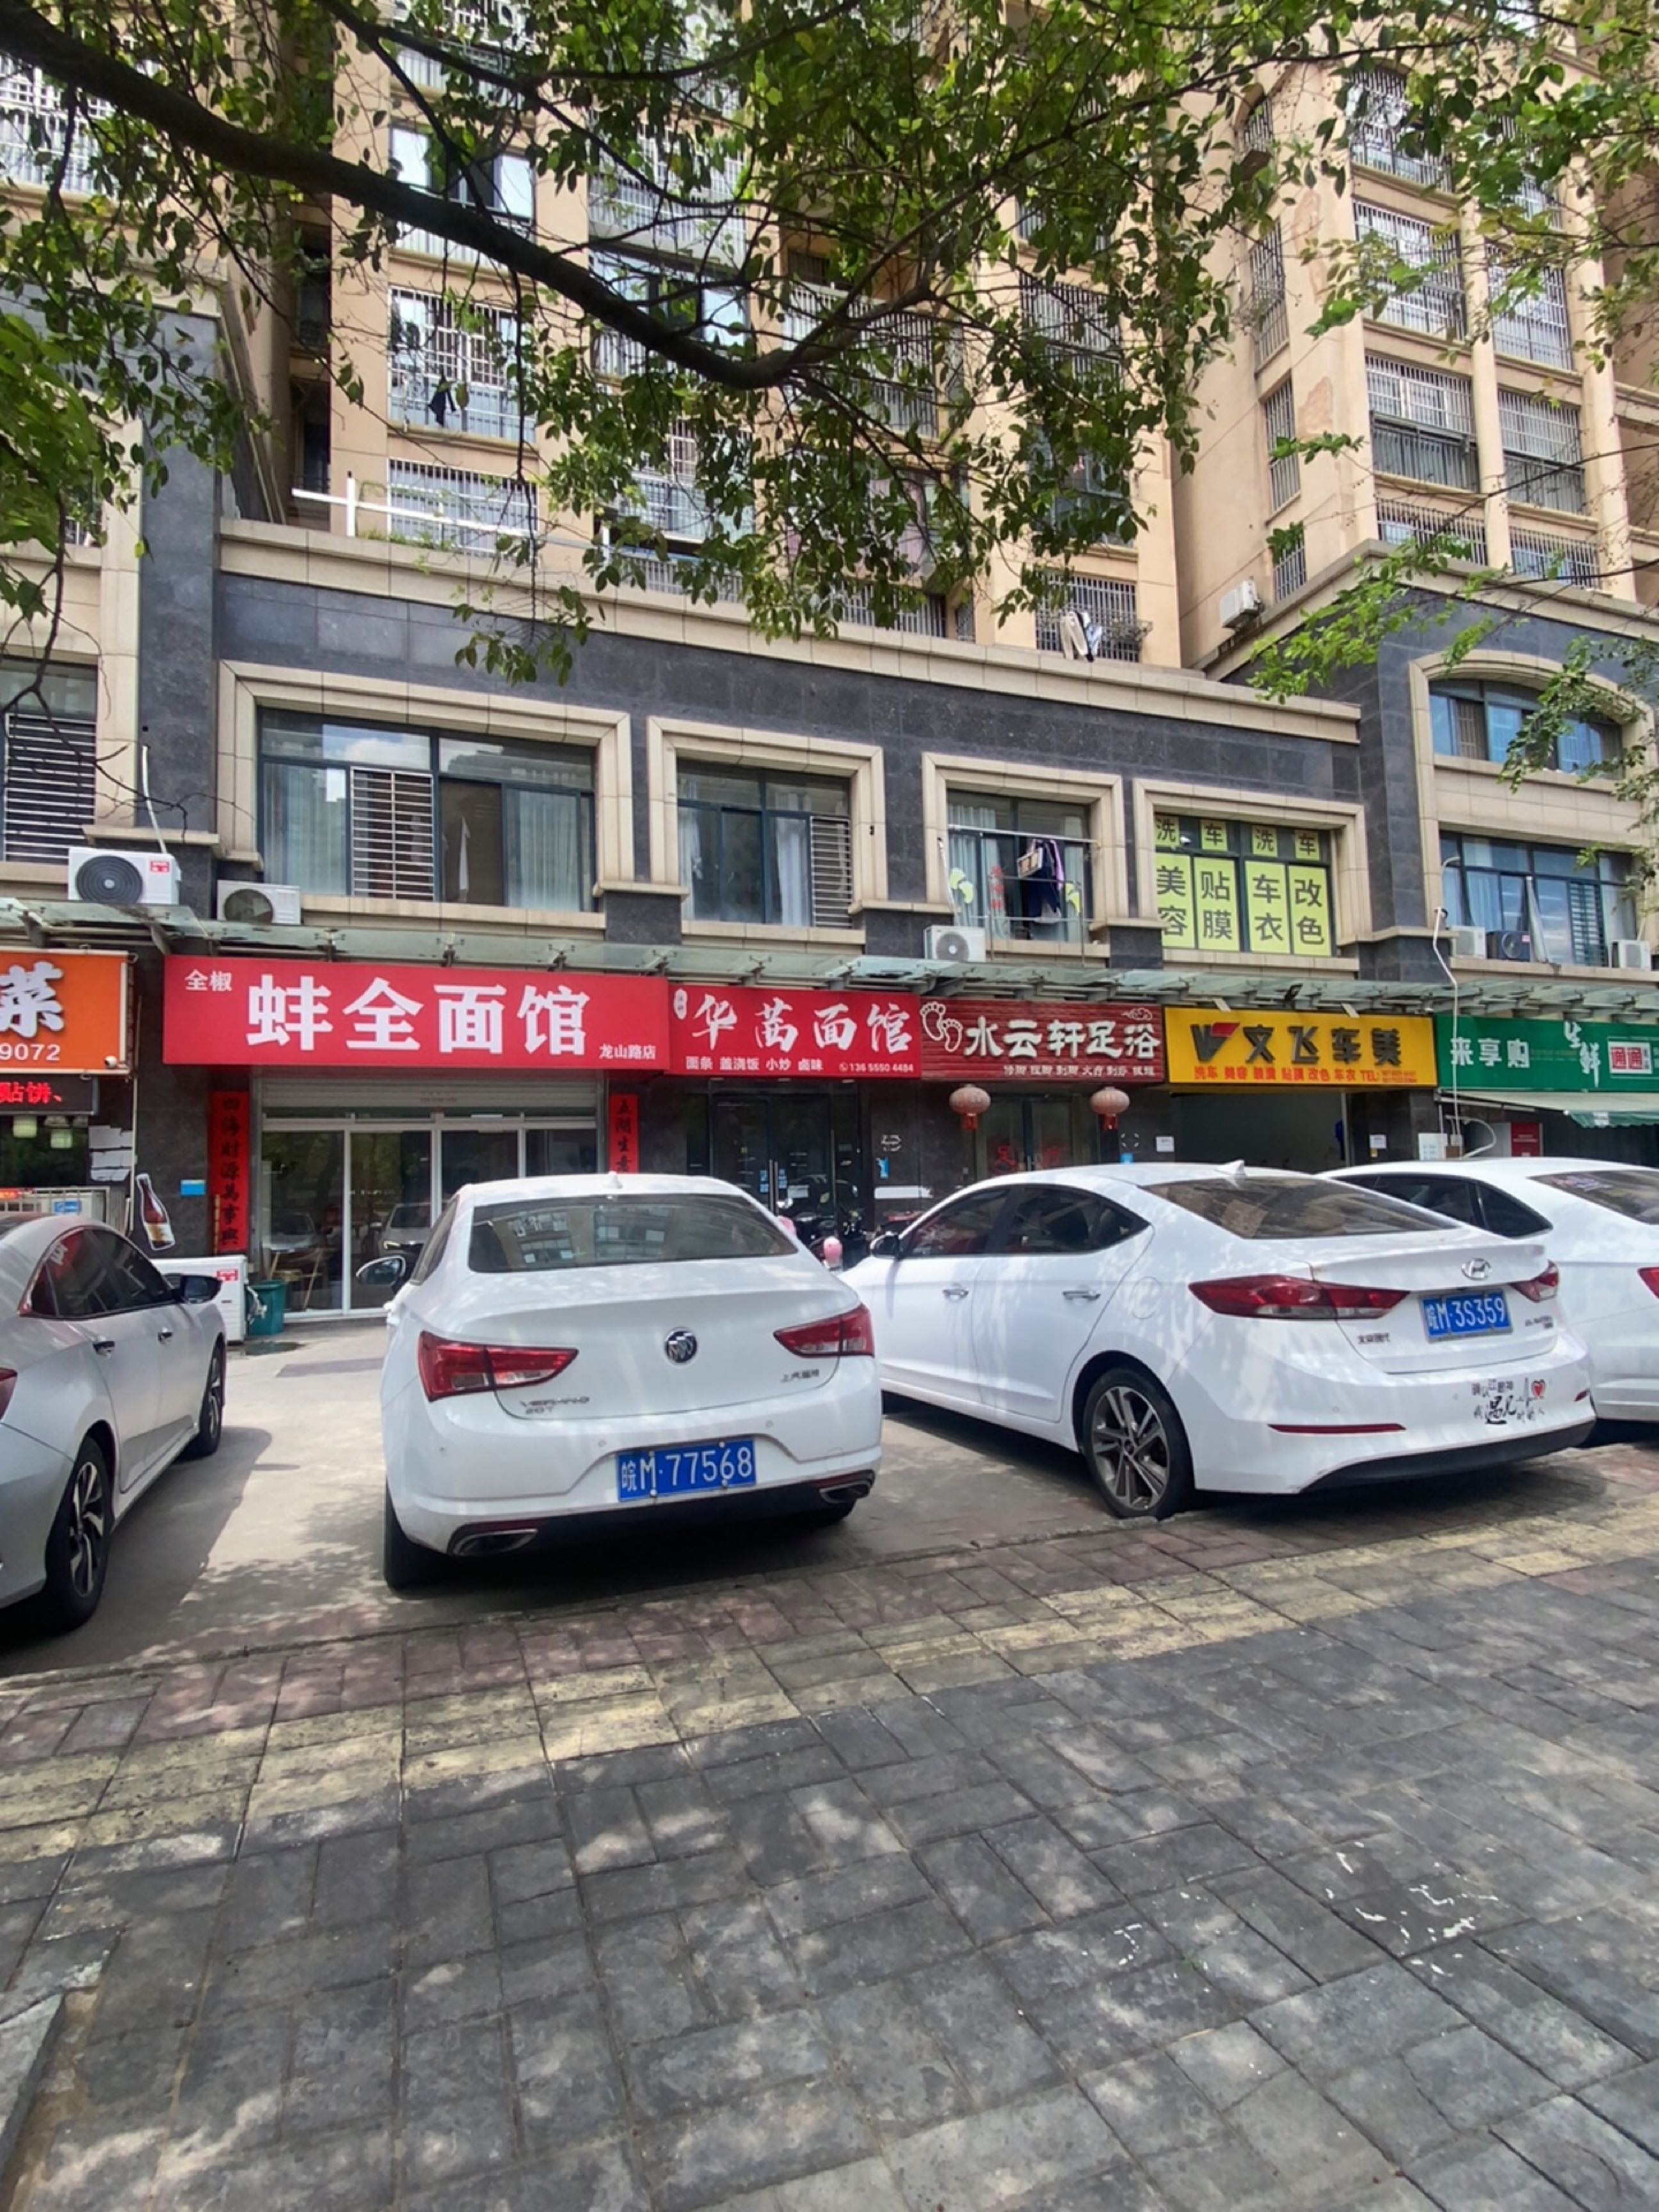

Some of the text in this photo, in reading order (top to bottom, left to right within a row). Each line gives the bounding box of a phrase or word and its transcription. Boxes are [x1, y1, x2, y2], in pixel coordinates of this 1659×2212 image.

[1157, 865, 1187, 936] 美容
[1200, 870, 1232, 940] 贴膜
[1252, 874, 1283, 942] 车衣
[1294, 879, 1324, 945] 改色
[185, 970, 232, 992] 全椒
[246, 974, 591, 1055] 蚌全面馆
[0, 1042, 61, 1061] 9072
[598, 1043, 656, 1060] 龙山路店
[964, 1016, 1160, 1059] 水云轩足浴
[1243, 1023, 1402, 1066] 文飞车美
[1450, 1037, 1530, 1068] 来享购
[766, 1057, 791, 1071] 小炒
